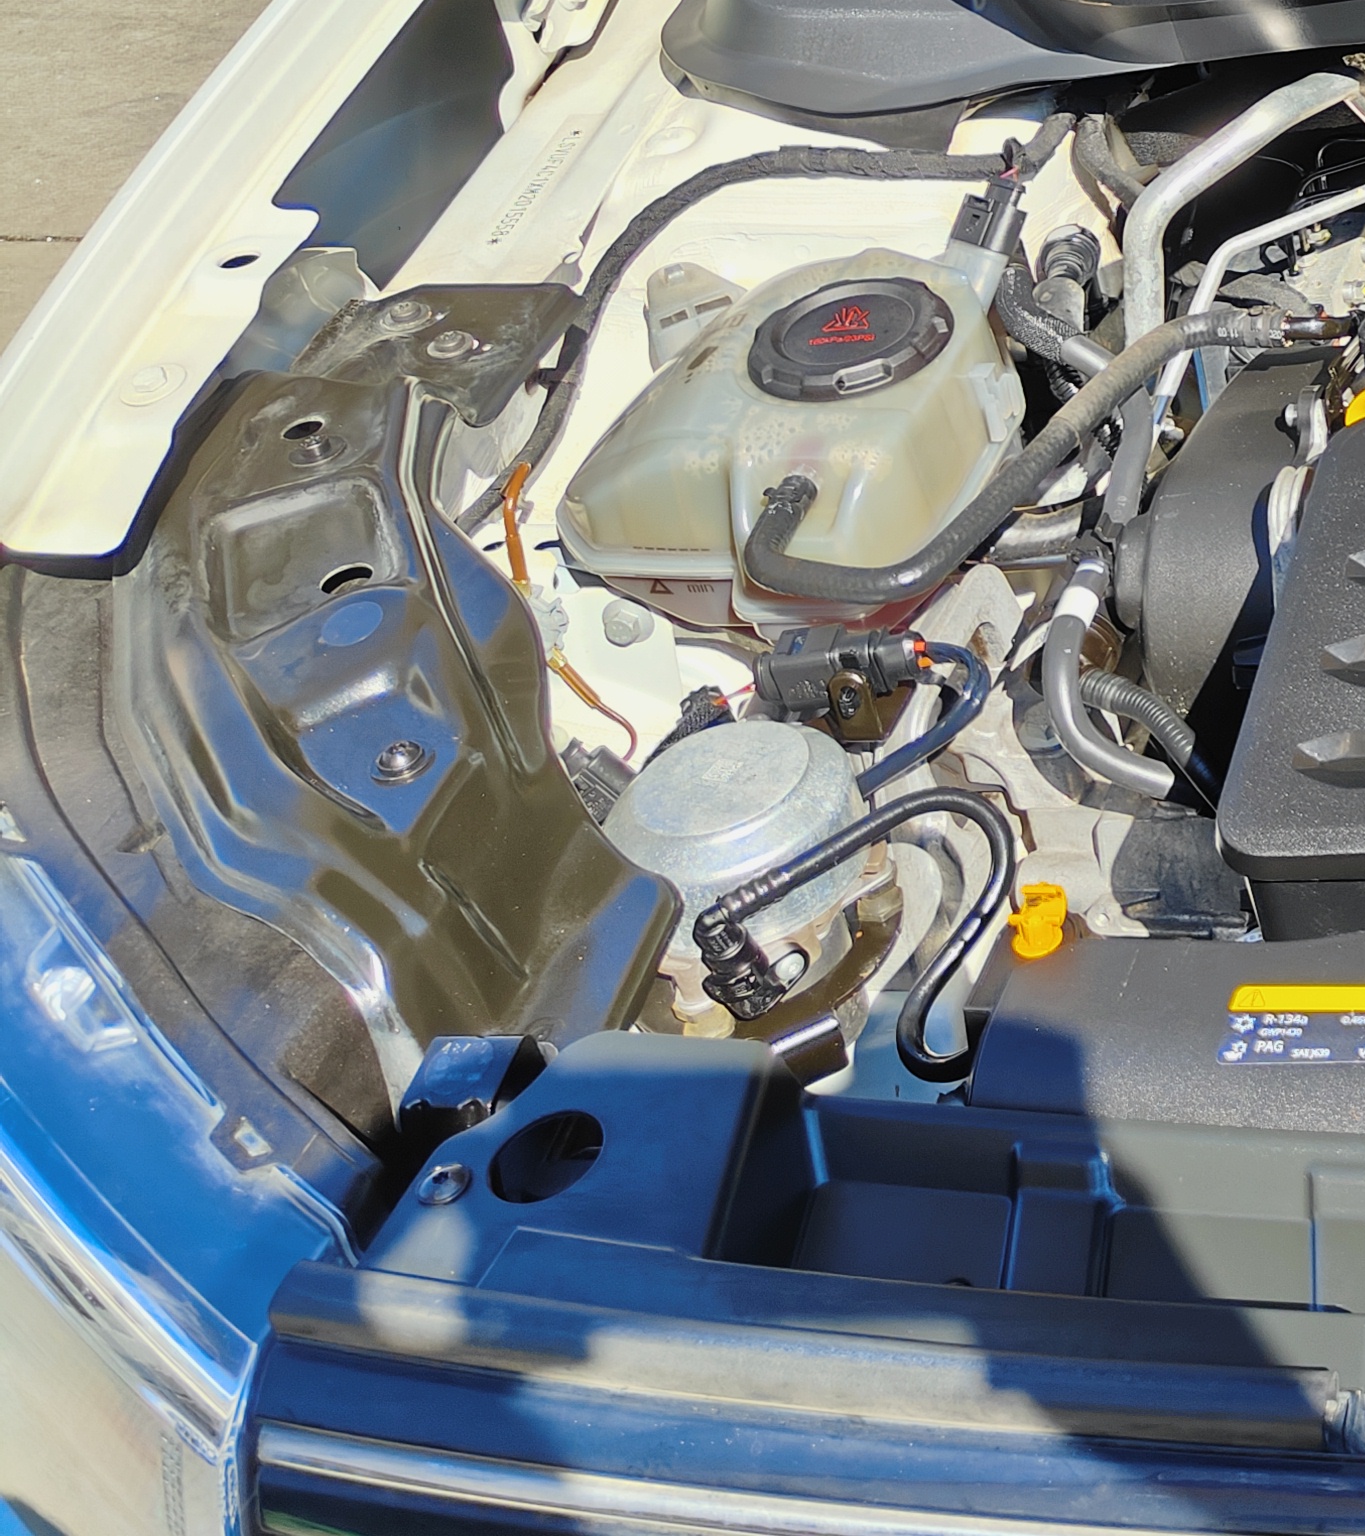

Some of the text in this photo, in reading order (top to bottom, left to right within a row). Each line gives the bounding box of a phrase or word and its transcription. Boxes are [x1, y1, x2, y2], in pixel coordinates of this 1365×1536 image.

[687, 584, 715, 593] min
[1263, 1013, 1308, 1025] R-134a
[1255, 1040, 1284, 1053] PAG
